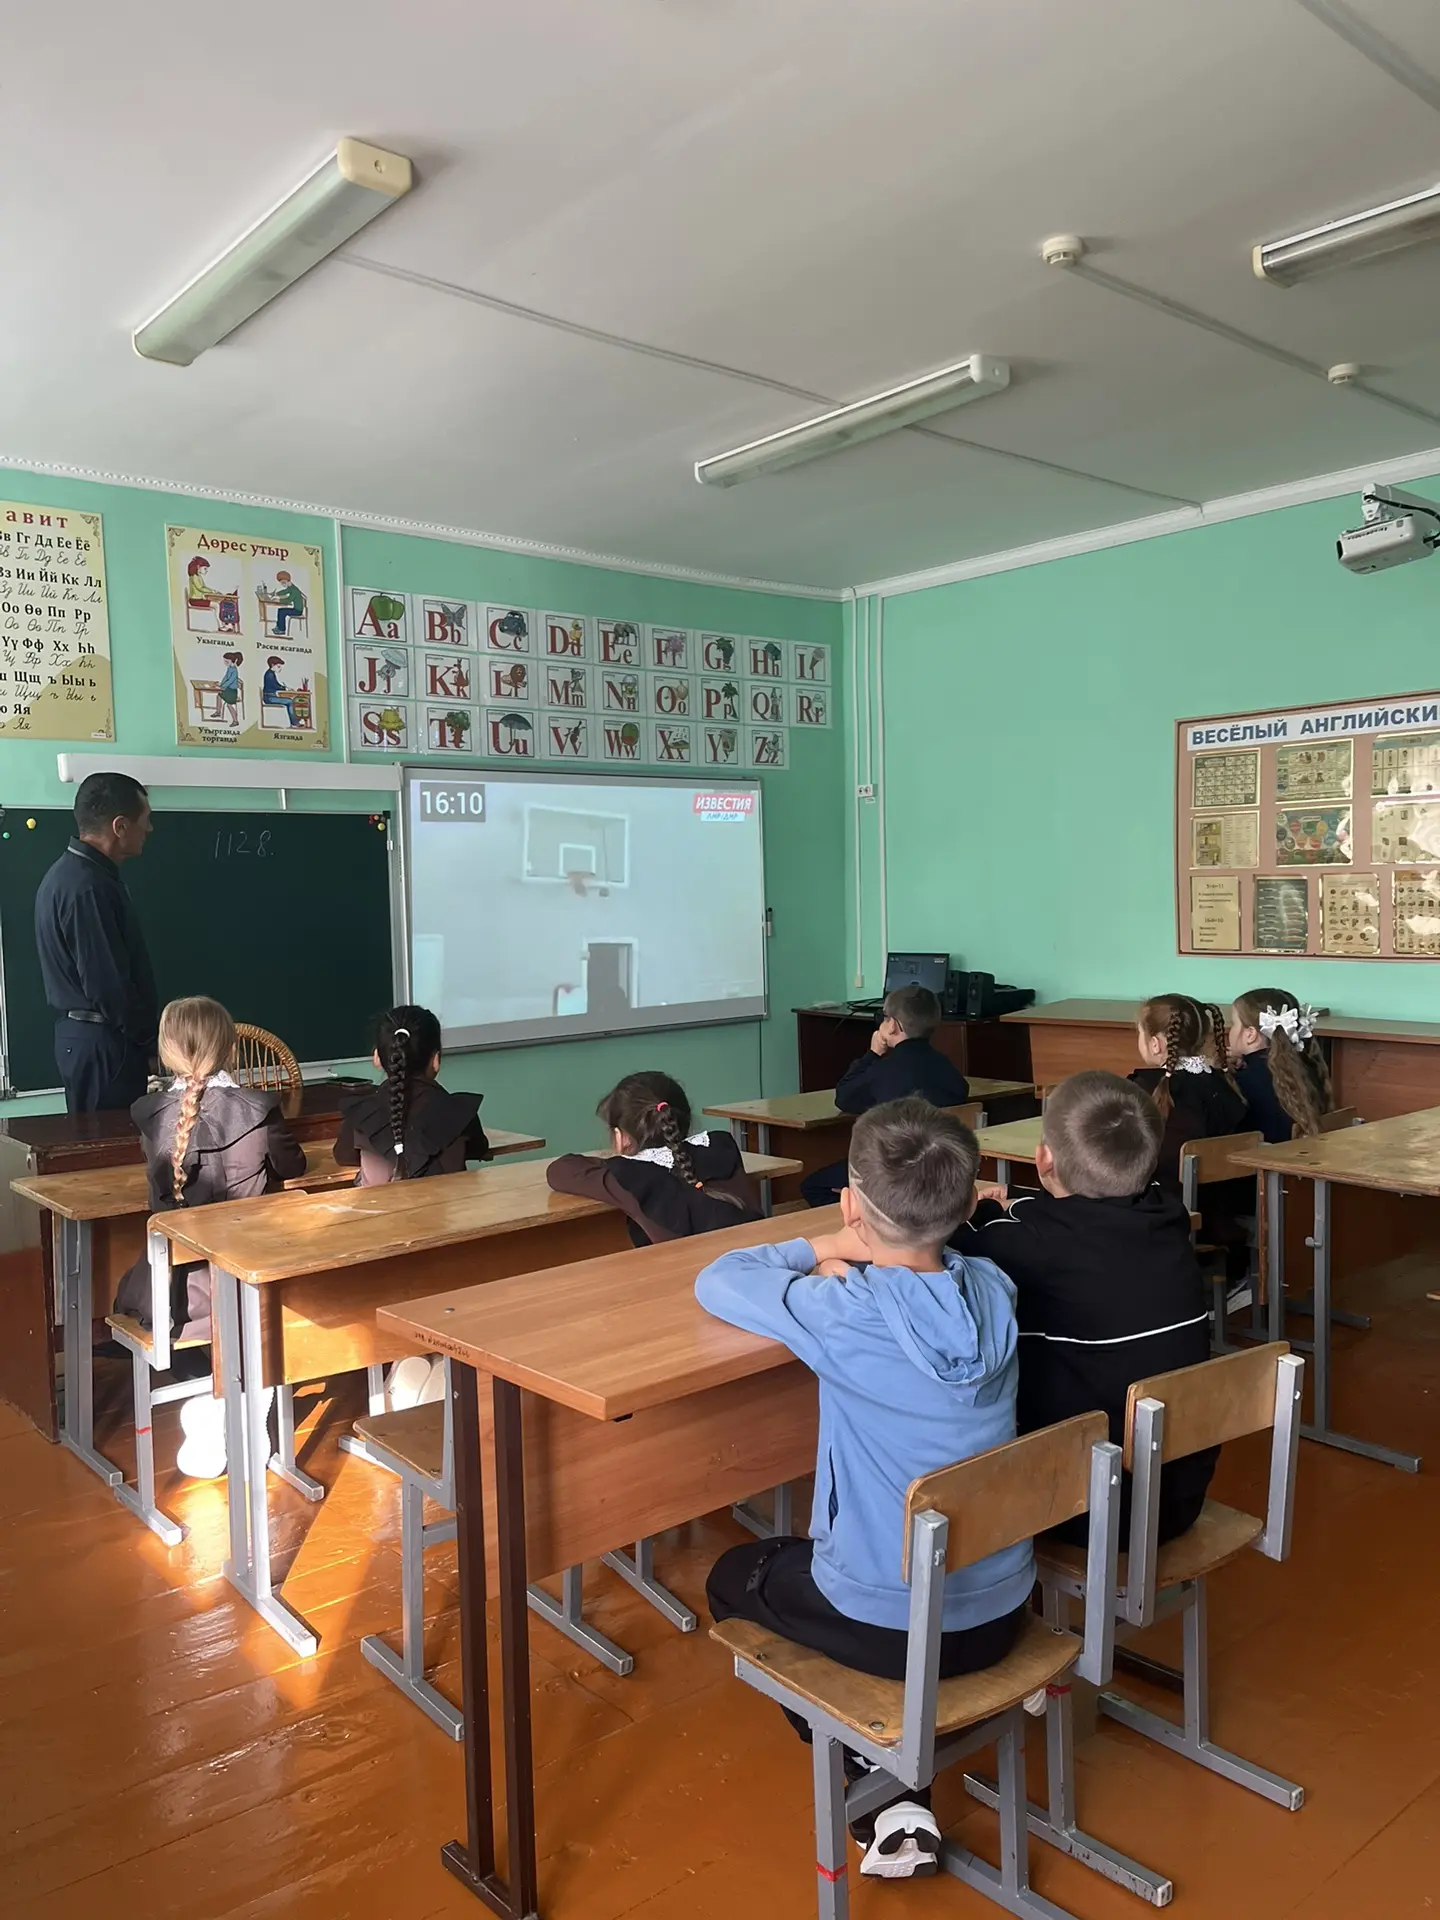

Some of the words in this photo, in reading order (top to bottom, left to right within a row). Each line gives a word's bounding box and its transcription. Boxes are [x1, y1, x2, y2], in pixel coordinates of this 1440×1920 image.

[16, 532, 31, 543] Гг
[35, 534, 53, 548] Дд
[57, 537, 72, 549] Ее
[76, 537, 91, 551] Ёё
[198, 534, 247, 554] Дөрес
[250, 544, 289, 561] утыр
[16, 568, 35, 580] Ии
[39, 568, 57, 583] Йй
[62, 573, 79, 586] Кк
[84, 576, 102, 588] Лл
[2, 602, 19, 614] Оо
[25, 604, 42, 616] Өө
[48, 606, 65, 618] Пп
[75, 609, 91, 622] Рр
[22, 638, 44, 652] Фф
[53, 640, 69, 652] Хх
[356, 598, 400, 639] Aa
[426, 611, 462, 644] Bb
[490, 618, 522, 650] Cc
[549, 625, 583, 656] Dd
[600, 630, 632, 664] Ee
[751, 648, 779, 676] Hh
[15, 671, 41, 685] Щщ
[62, 675, 85, 687] Ыы
[359, 657, 391, 694] Jj
[427, 665, 468, 698] Kk
[550, 679, 583, 706] Mm
[605, 681, 636, 710] Nn
[656, 686, 686, 714] Oo
[704, 688, 733, 719] Pp
[799, 696, 824, 723] Rr
[14, 704, 31, 715] Яя
[1192, 719, 1288, 746] ВЕСЁЛЫЙ
[1300, 704, 1439, 735] АНГЛИЙСКИ
[363, 712, 401, 746] Ss
[430, 719, 466, 749] Tt
[489, 721, 529, 755] Uu
[605, 729, 637, 757] Ww
[658, 730, 686, 760] Xx
[422, 791, 483, 814] 16:10
[696, 797, 752, 810] ИЗВЕСТИЯ
